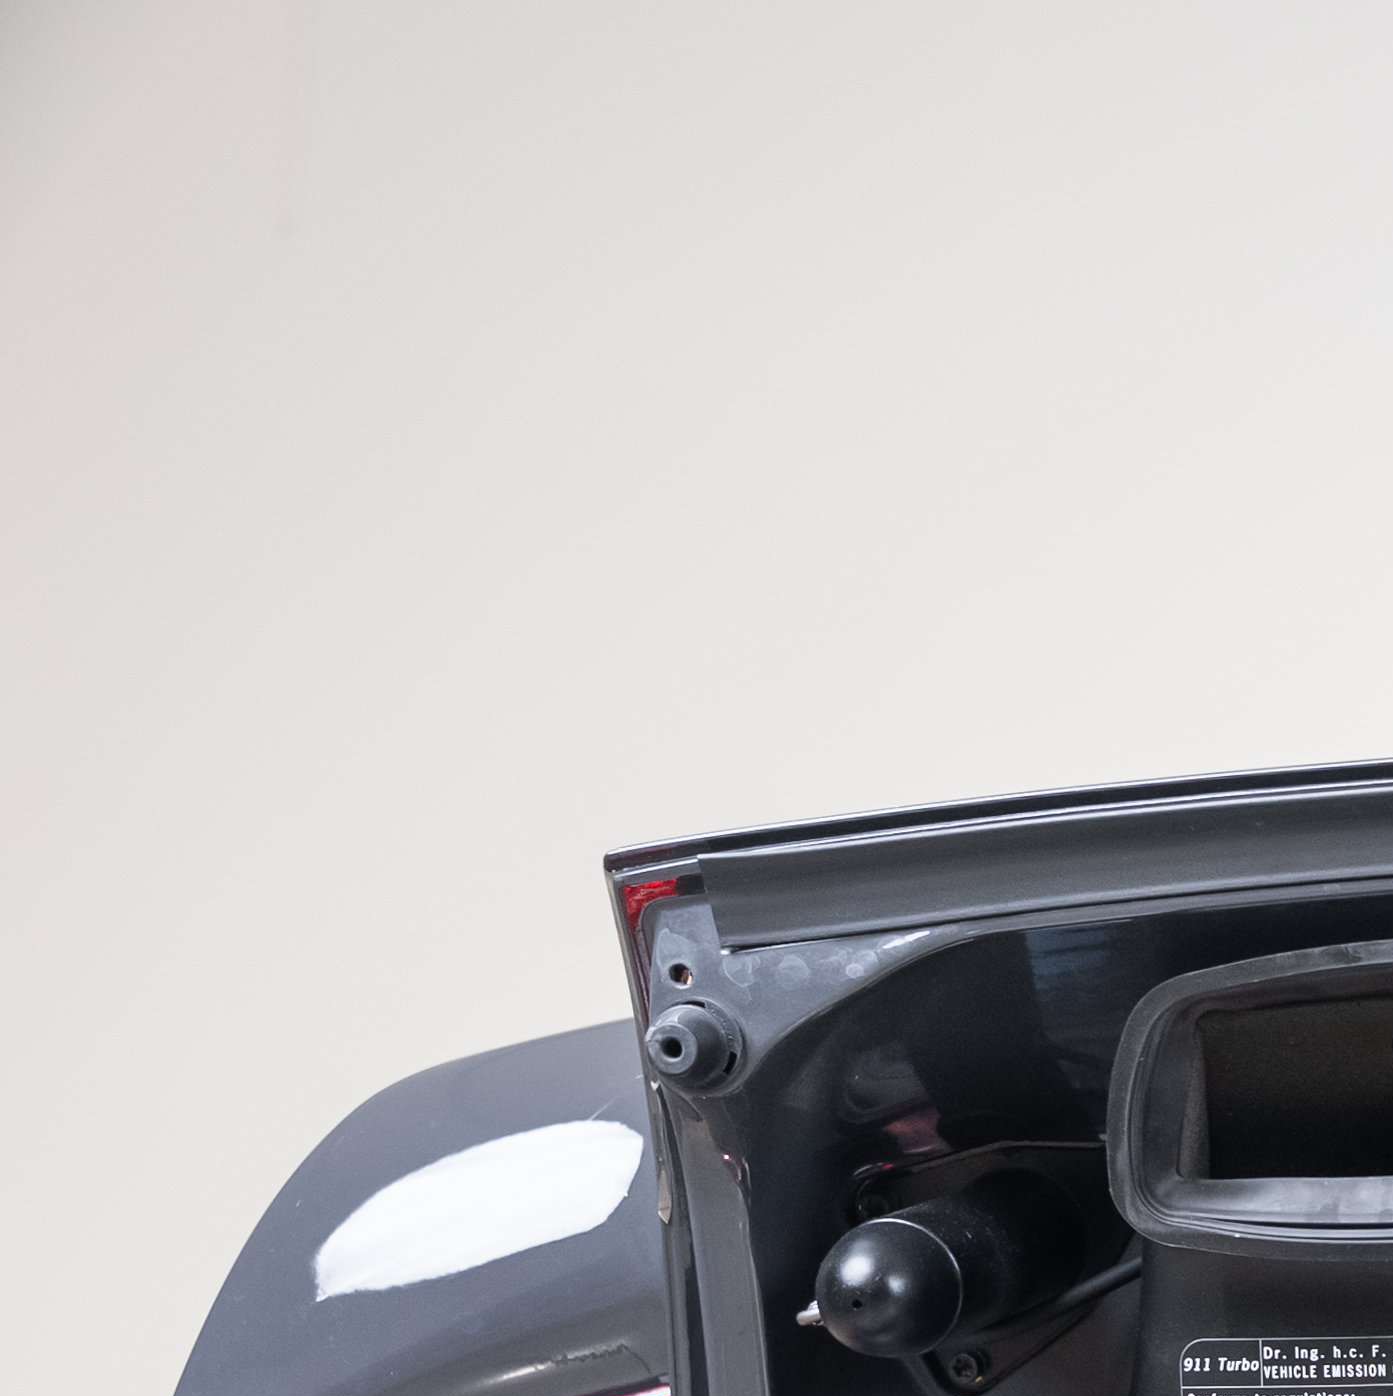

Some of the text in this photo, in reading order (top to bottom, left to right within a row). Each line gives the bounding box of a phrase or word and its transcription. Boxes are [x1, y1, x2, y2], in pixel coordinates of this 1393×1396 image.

[1263, 1346, 1287, 1359] Dr.
[1295, 1346, 1326, 1361] Ing.
[1333, 1345, 1364, 1359] h.c.
[1372, 1345, 1386, 1358] F.
[1183, 1357, 1260, 1372] 911 Turbo
[1264, 1364, 1318, 1379] VEHICLE
[1323, 1363, 1387, 1378] EMISSION
